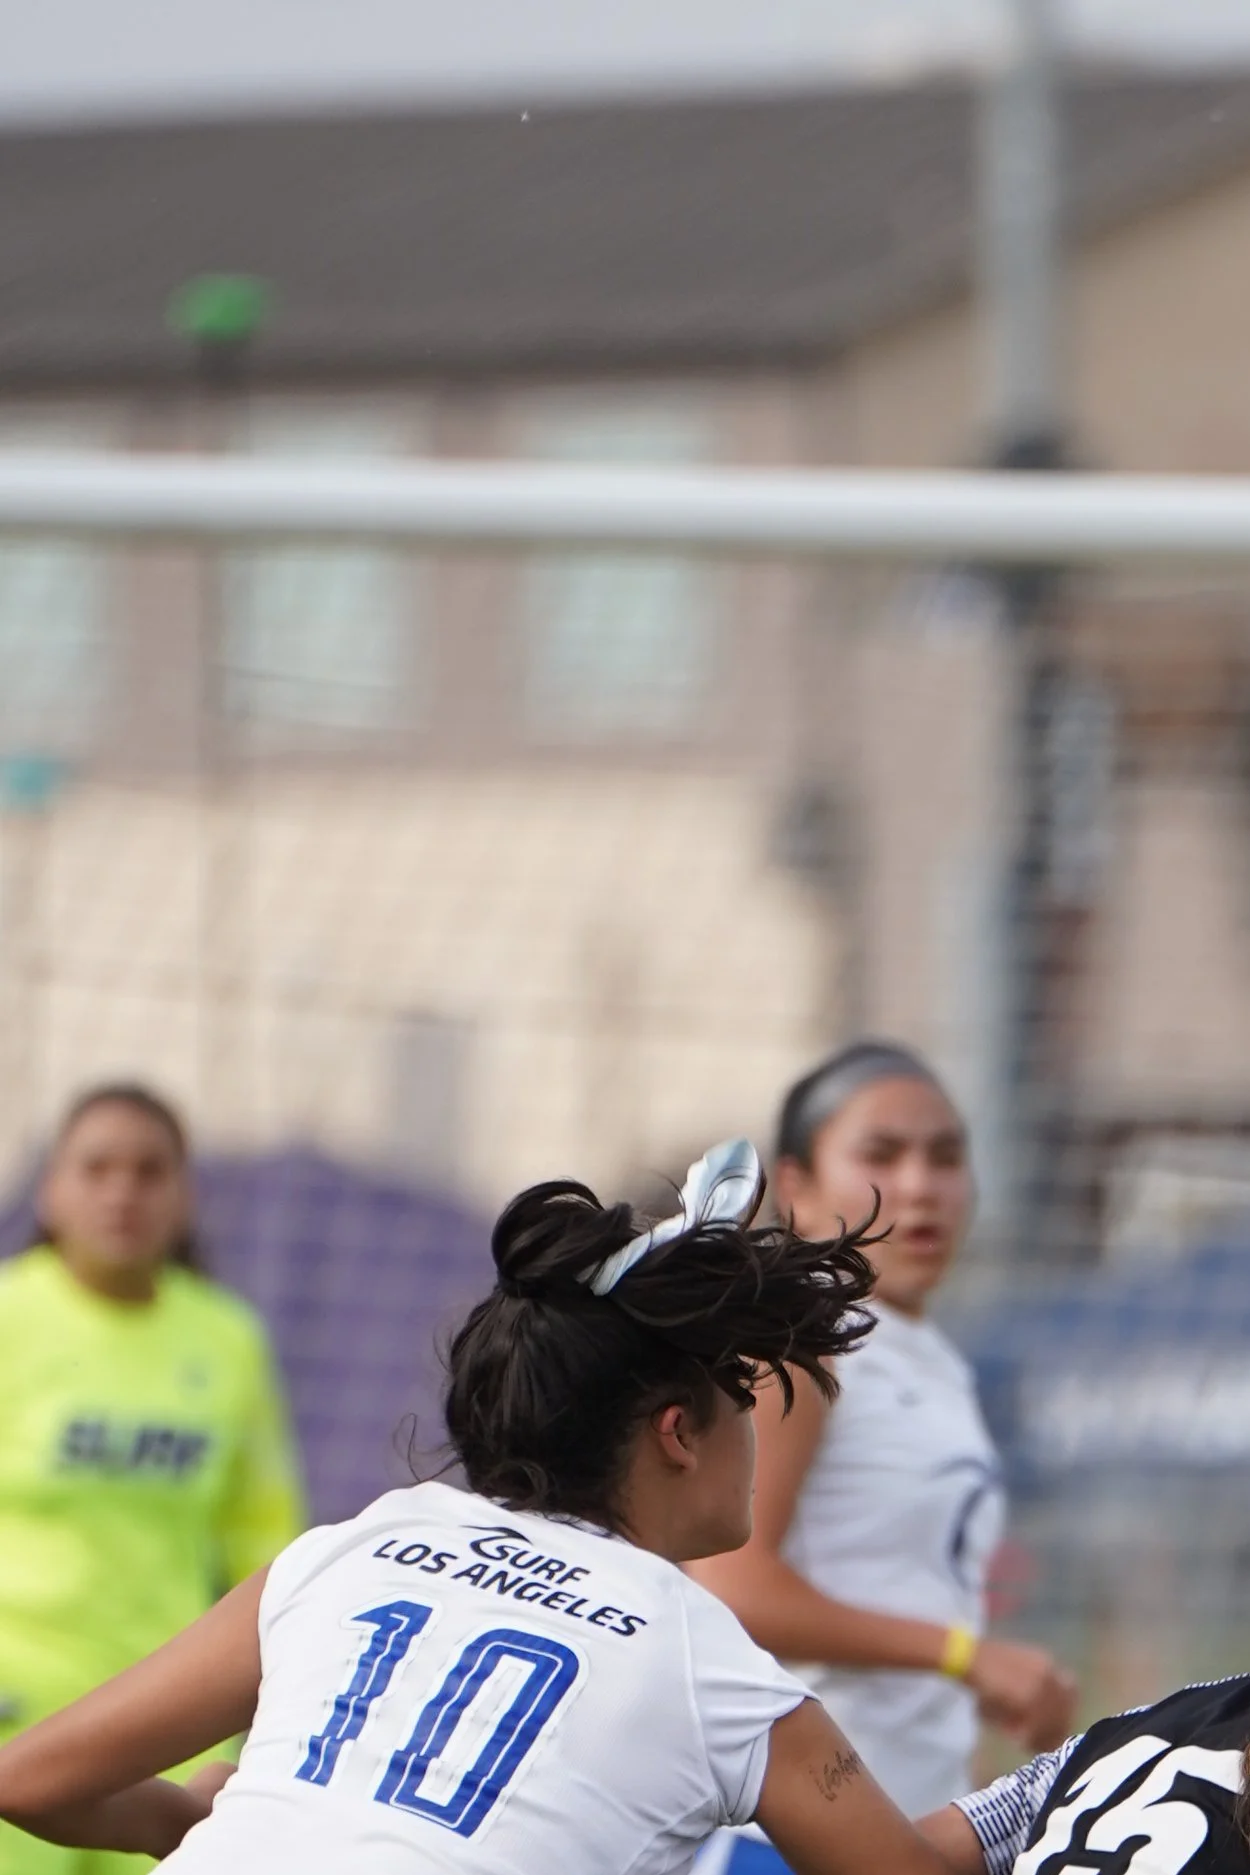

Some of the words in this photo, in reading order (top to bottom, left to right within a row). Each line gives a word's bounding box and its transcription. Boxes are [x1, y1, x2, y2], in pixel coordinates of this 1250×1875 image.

[372, 1539, 458, 1575] LOS
[451, 1562, 648, 1637] ANGELES
[470, 1533, 591, 1585] SURF
[293, 1599, 580, 1839] 10
